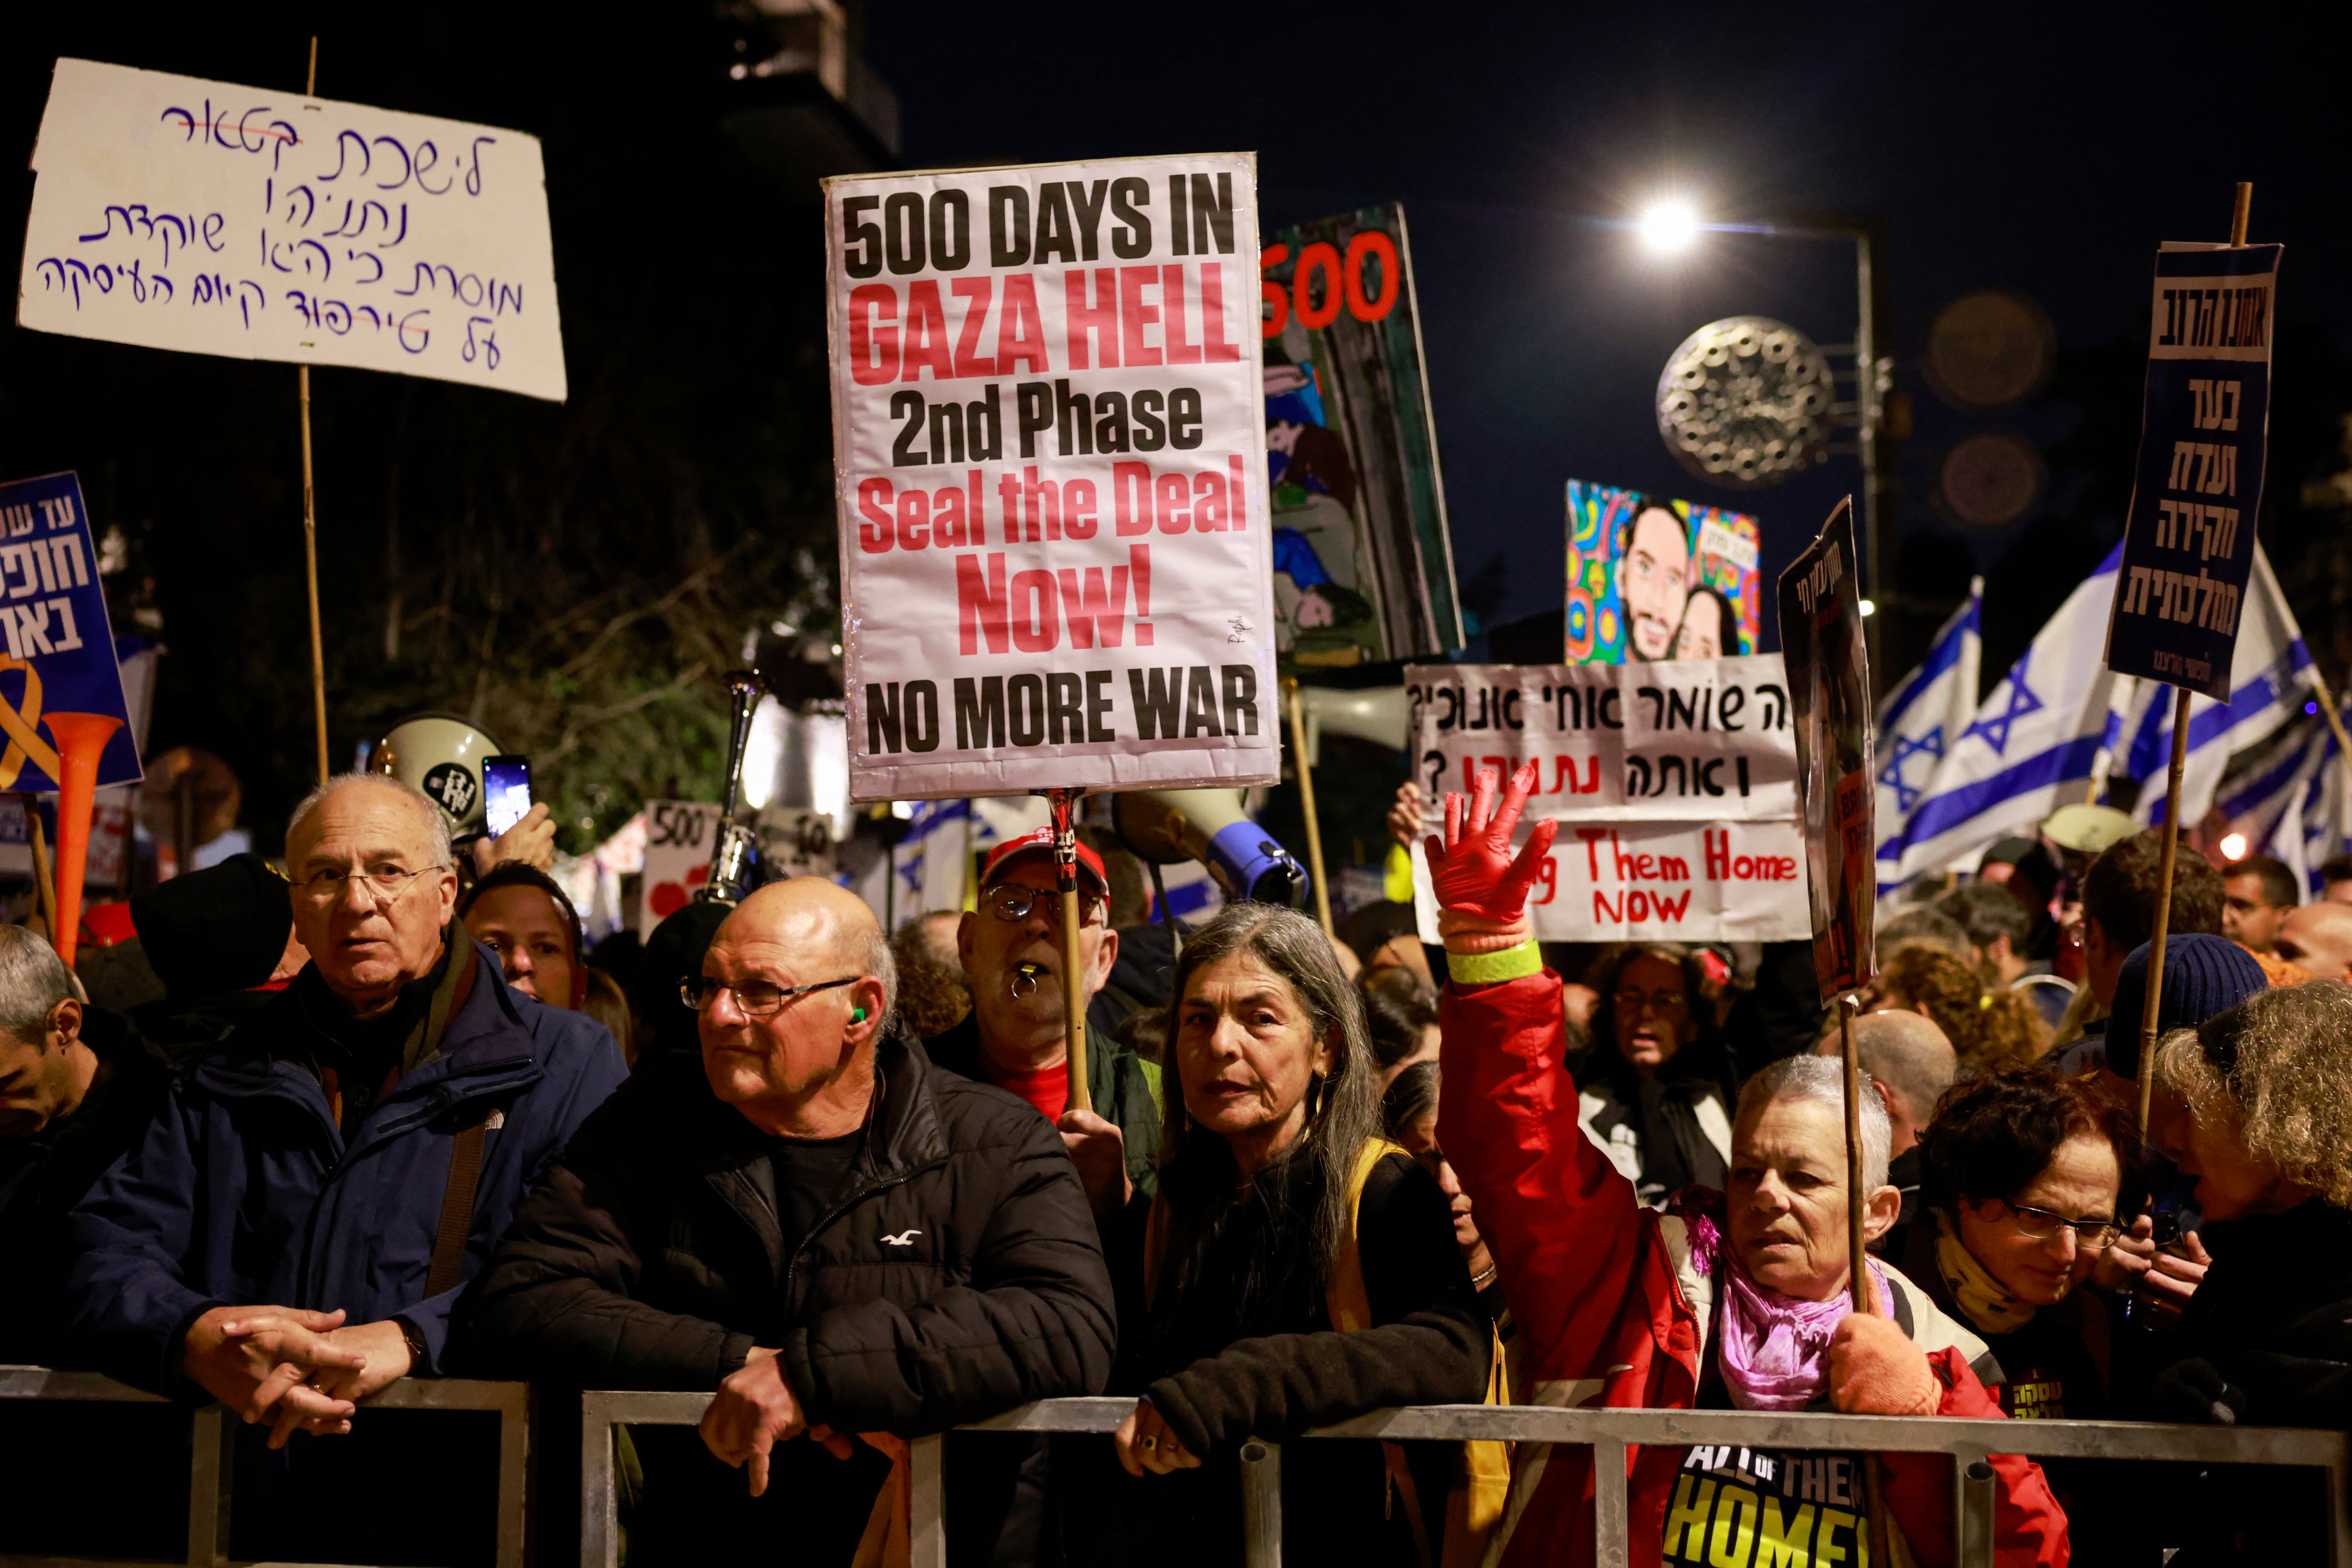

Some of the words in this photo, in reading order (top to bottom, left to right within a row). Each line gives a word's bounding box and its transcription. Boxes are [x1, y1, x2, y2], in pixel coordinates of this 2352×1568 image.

[161, 99, 297, 171] קטאר
[318, 130, 496, 196] לישכת
[79, 205, 224, 267] שוקדת
[266, 178, 407, 247] נתניהו
[843, 188, 970, 279] 500
[989, 176, 1151, 267] DAYS
[1170, 172, 1234, 256] IN
[37, 256, 173, 311] העיסקה
[262, 229, 331, 281] היא
[349, 249, 384, 284] כי
[192, 274, 264, 329] קיום
[395, 262, 524, 315] מוסרת
[286, 291, 431, 353] טירפוד
[461, 316, 500, 370] על
[848, 273, 1049, 386] GAZA
[1065, 263, 1240, 371] HELL
[890, 383, 1000, 468] 2nd
[1018, 379, 1203, 459] Phase
[2188, 378, 2241, 431] בעד
[2169, 441, 2238, 497] ועדת
[38, 495, 76, 531] עד
[858, 470, 984, 554] Seal
[998, 466, 1097, 544] the
[1113, 455, 1248, 537] Deal
[2156, 499, 2240, 561] חקירה
[0, 532, 90, 599] חופ
[2122, 565, 2239, 637] ממלכתית
[866, 680, 939, 755] NO
[954, 670, 1115, 751] MORE
[1128, 664, 1259, 741] WAR
[1576, 828, 1690, 882] Them
[1704, 828, 1798, 881] Home
[1594, 889, 1691, 924] NOW
[2013, 1381, 2063, 1407] עסקה
[1684, 1446, 1756, 1487] ALL
[1755, 1454, 1779, 1482] OF
